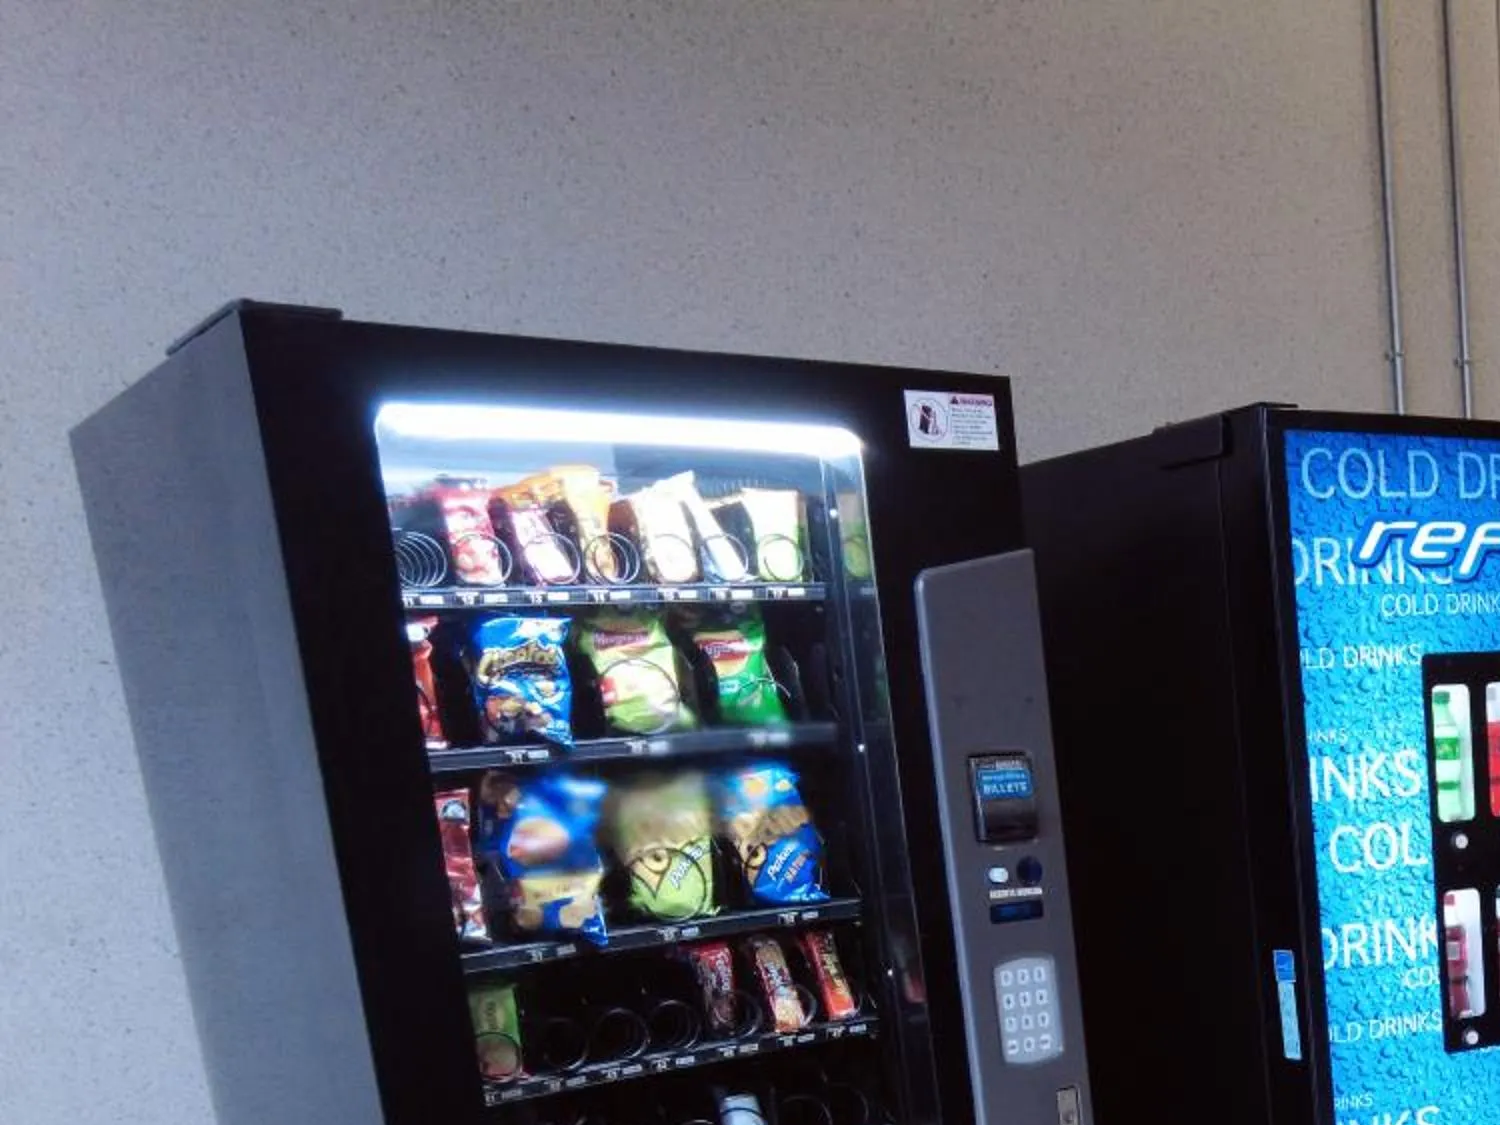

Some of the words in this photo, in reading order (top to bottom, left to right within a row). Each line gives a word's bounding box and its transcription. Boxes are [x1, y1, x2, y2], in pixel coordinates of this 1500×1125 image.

[1301, 447, 1439, 499] COLD
[1381, 593, 1439, 617] COLD
[1300, 647, 1335, 669] LD
[1343, 643, 1422, 669] DRINKS
[1310, 749, 1422, 804] INKS
[1329, 820, 1430, 873] COL
[1329, 1021, 1362, 1044] LD
[1369, 1008, 1443, 1040] DRINKS
